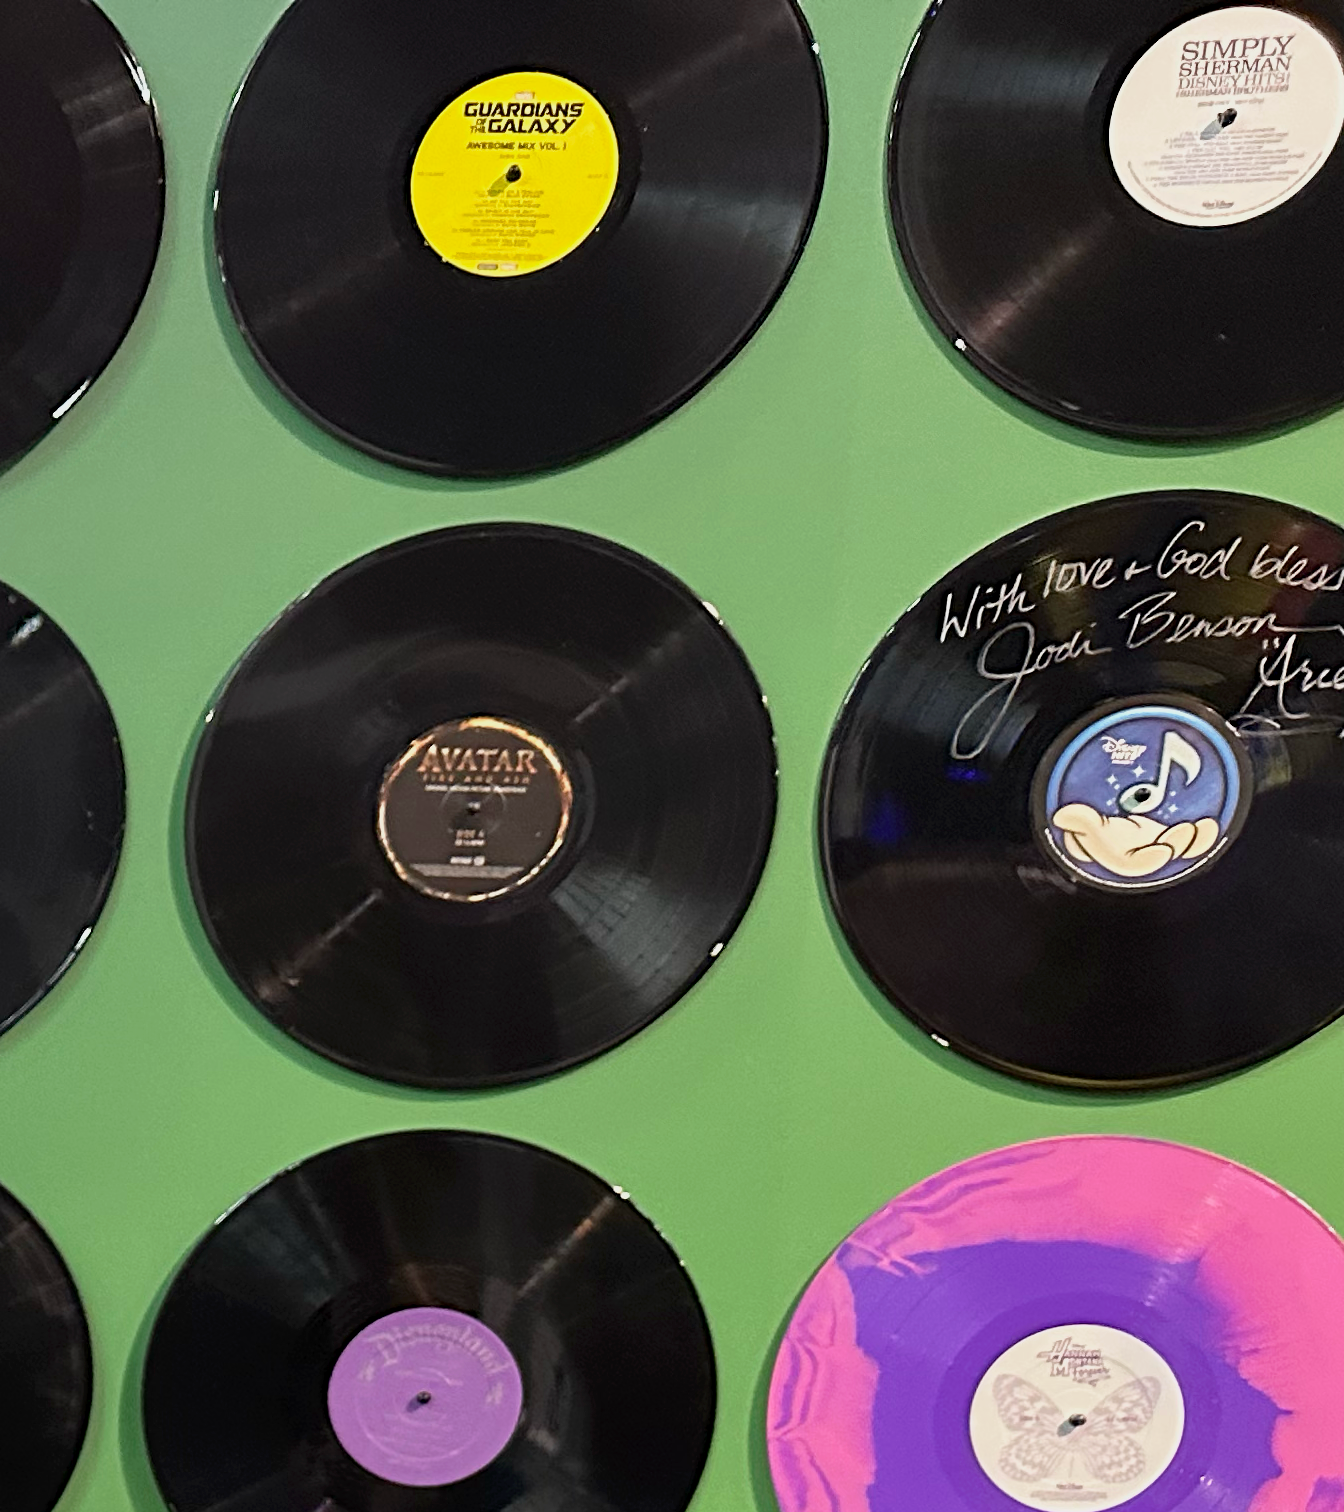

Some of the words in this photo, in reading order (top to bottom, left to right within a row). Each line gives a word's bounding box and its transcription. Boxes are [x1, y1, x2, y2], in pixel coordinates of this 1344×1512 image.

[1181, 33, 1296, 61] SIMPLY
[1178, 56, 1293, 78] SHERMAN
[1177, 74, 1240, 89] DISNEY
[464, 102, 585, 118] GUARDIANS
[487, 118, 576, 134] GALAXY
[466, 141, 515, 150] AWESOME
[518, 142, 536, 150] MIX
[940, 572, 1035, 642] With
[1042, 559, 1116, 598] love
[1157, 521, 1242, 581] God
[1249, 545, 1344, 590] bless
[951, 621, 1114, 760] Jodi
[1118, 591, 1290, 651] Benson
[416, 744, 537, 774] AVATAR
[366, 1324, 512, 1374] Disneyland
